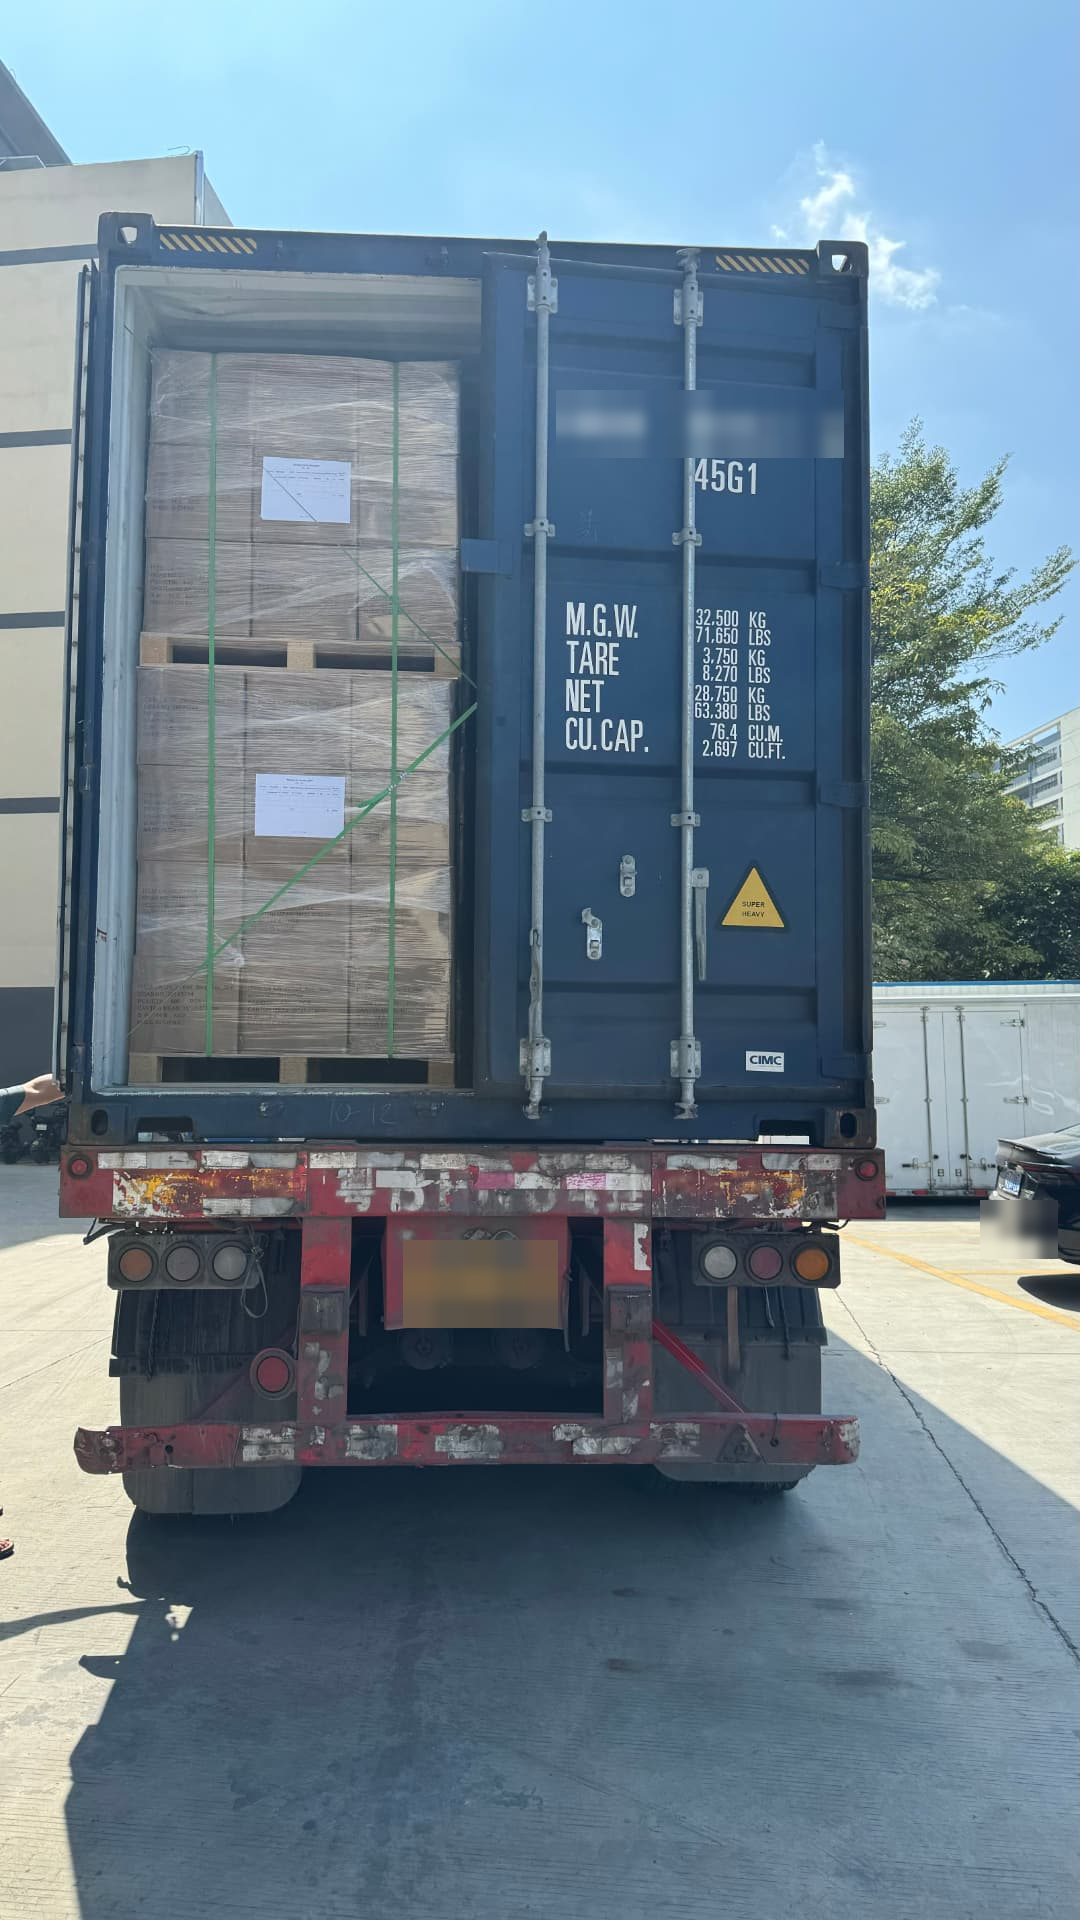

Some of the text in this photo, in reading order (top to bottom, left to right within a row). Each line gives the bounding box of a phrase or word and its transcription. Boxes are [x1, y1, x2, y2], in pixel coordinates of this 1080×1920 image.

[694, 458, 757, 495] 45G1
[566, 601, 638, 638] M.G.W.
[749, 611, 766, 628] KG
[748, 628, 771, 646] LBS
[566, 640, 620, 676] TARE
[748, 649, 766, 667] KG
[748, 666, 771, 684] LBS
[565, 678, 605, 713] NET
[748, 687, 765, 704] KG
[748, 704, 770, 722] LBS
[709, 722, 784, 742] 76.4 CU.M.
[749, 1055, 783, 1066] CIMC
